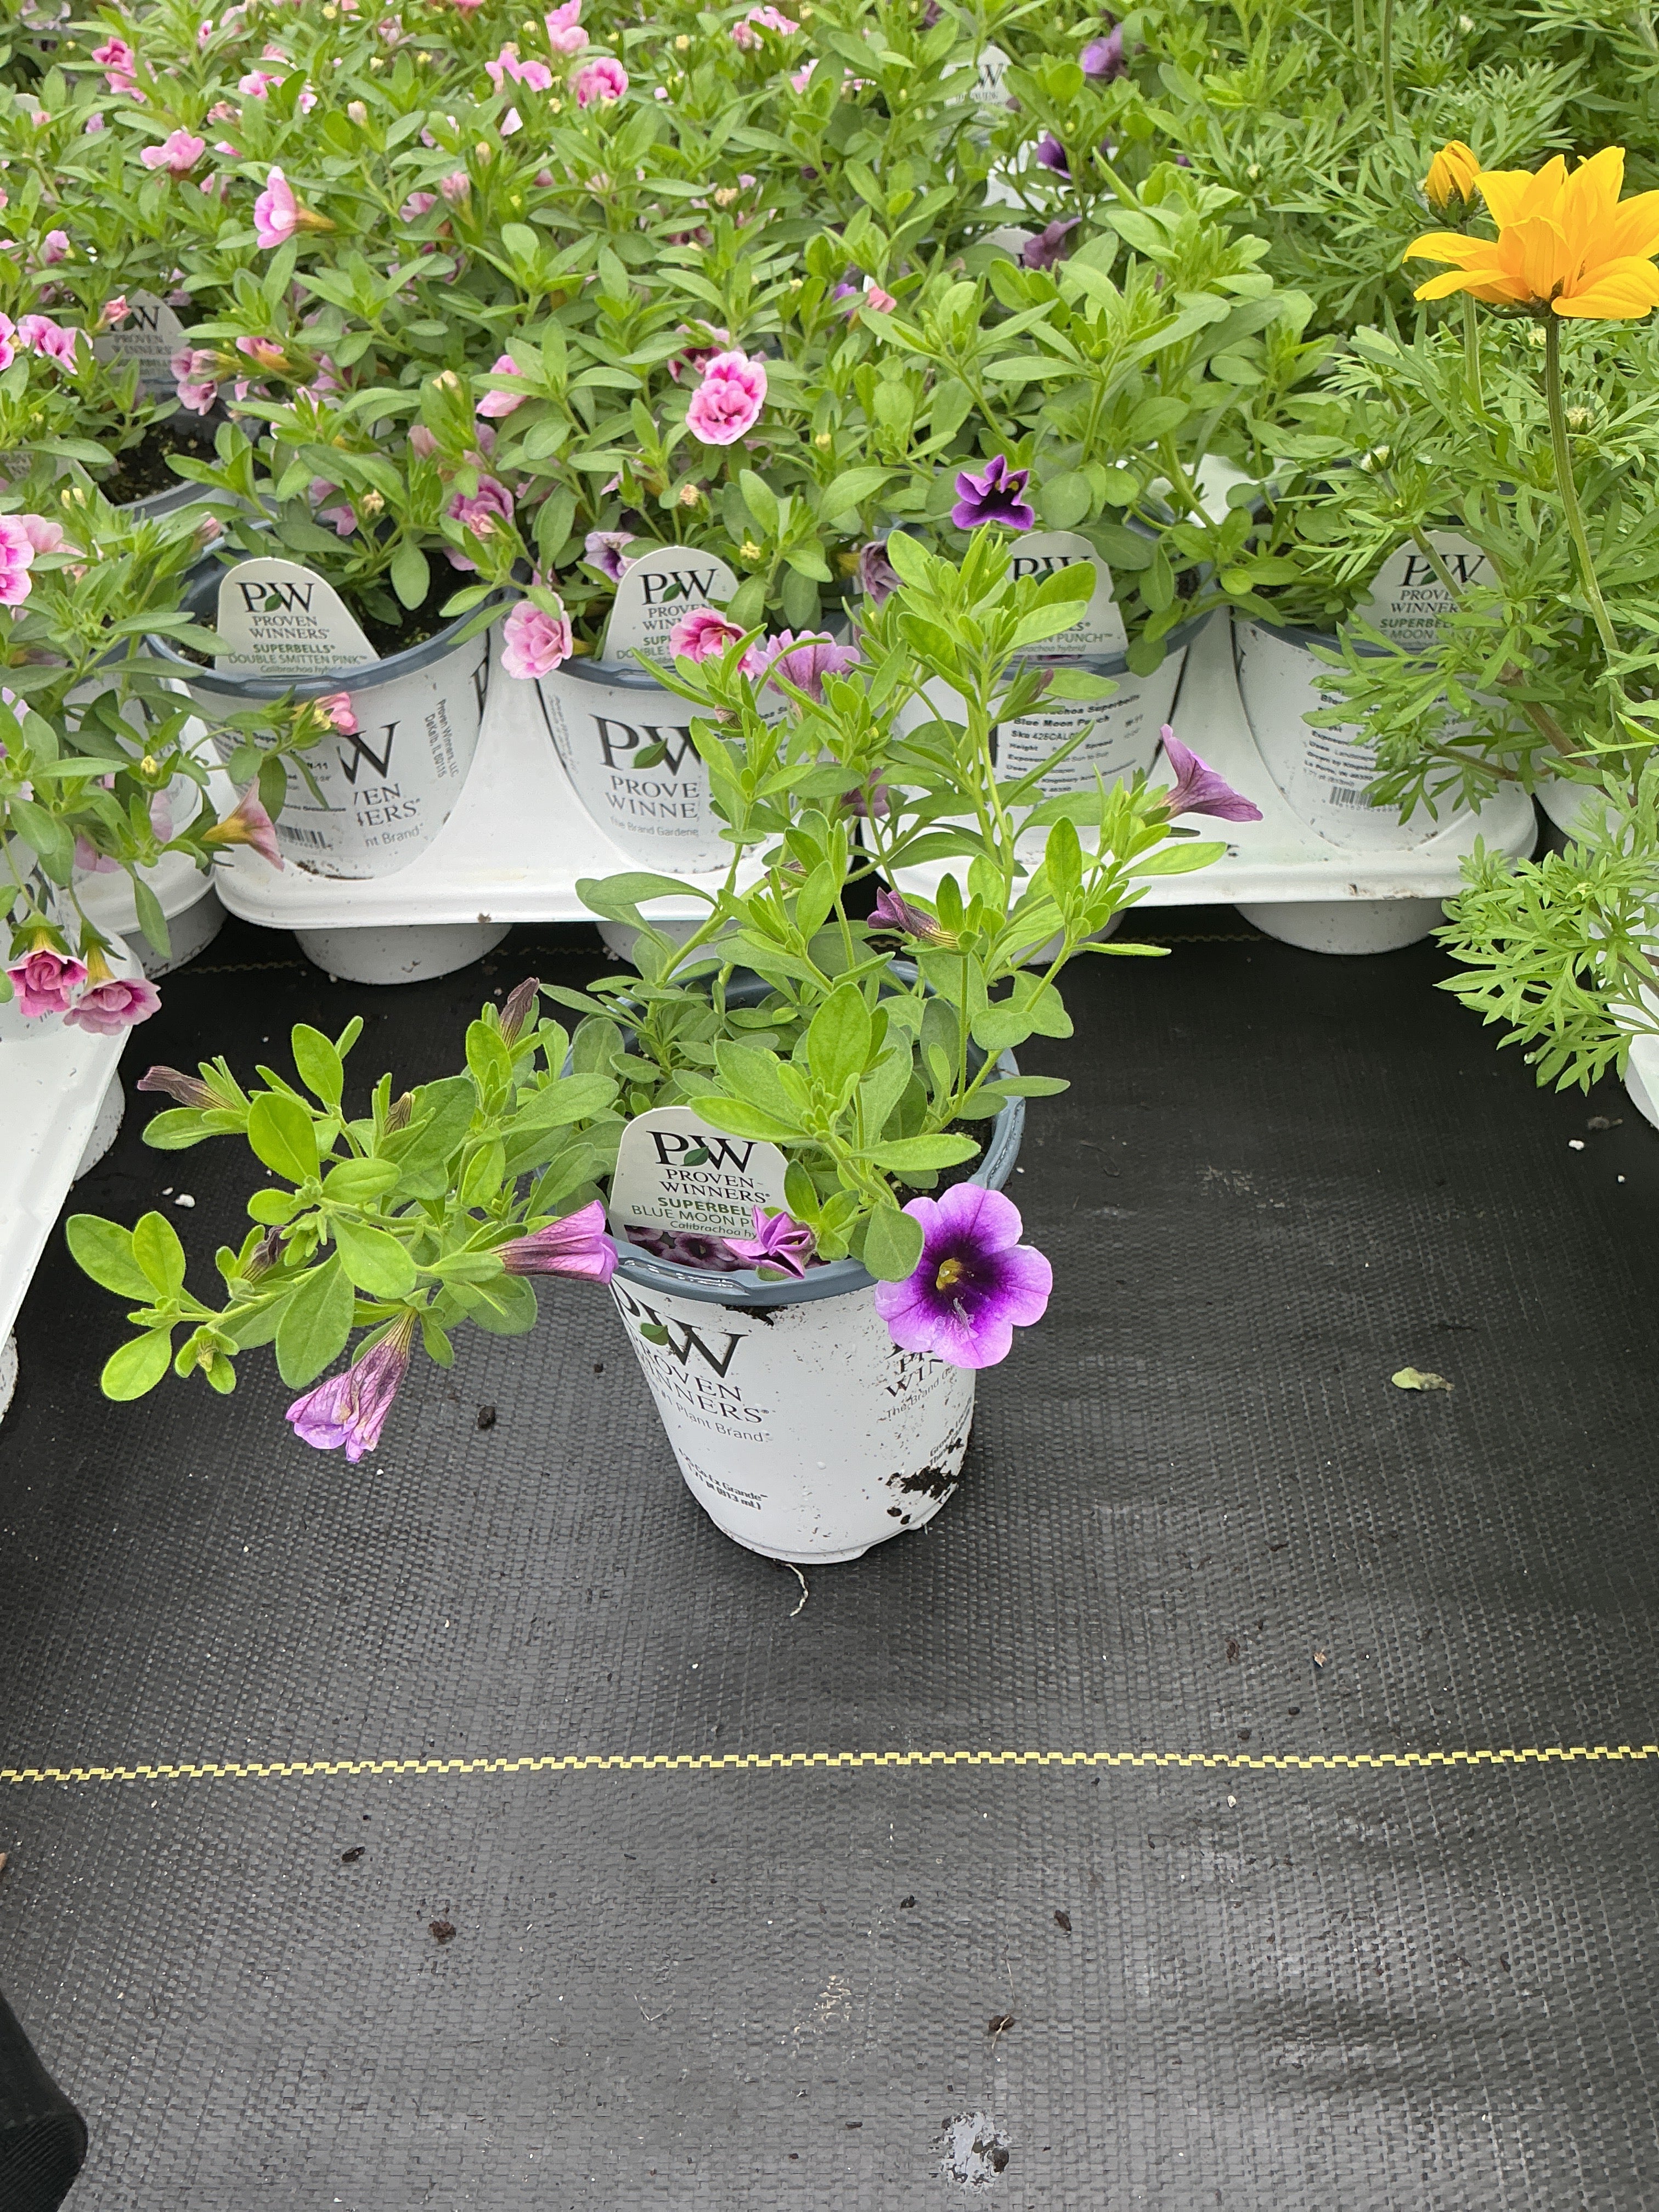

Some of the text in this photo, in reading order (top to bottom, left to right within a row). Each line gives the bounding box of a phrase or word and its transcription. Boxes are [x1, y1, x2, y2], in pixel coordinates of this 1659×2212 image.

[637, 568, 719, 605] PW
[1400, 589, 1454, 601] PROVE
[235, 582, 315, 613] PW
[1391, 602, 1458, 613] WINNER
[251, 616, 318, 627] PROVEN
[228, 654, 278, 664] DOUBLE
[280, 654, 330, 664] SMITTEN
[616, 645, 664, 659] DOBLE
[1014, 714, 1110, 727] Blue Moon Puch
[436, 698, 448, 729] Proven
[449, 761, 460, 778] LLC
[610, 775, 700, 798] PROVE
[605, 792, 698, 819] WINNE
[657, 827, 699, 837] Gardene
[646, 1130, 758, 1174] PW
[665, 1168, 754, 1189] PROVEN
[631, 1205, 675, 1219] BLUE
[679, 1210, 735, 1226] MOON
[657, 1197, 752, 1217] SUPERBEL
[670, 1221, 741, 1237] Calibrachoa
[910, 1378, 940, 1406] Brand
[676, 1402, 712, 1430] Plant
[715, 1422, 764, 1442] Brand
